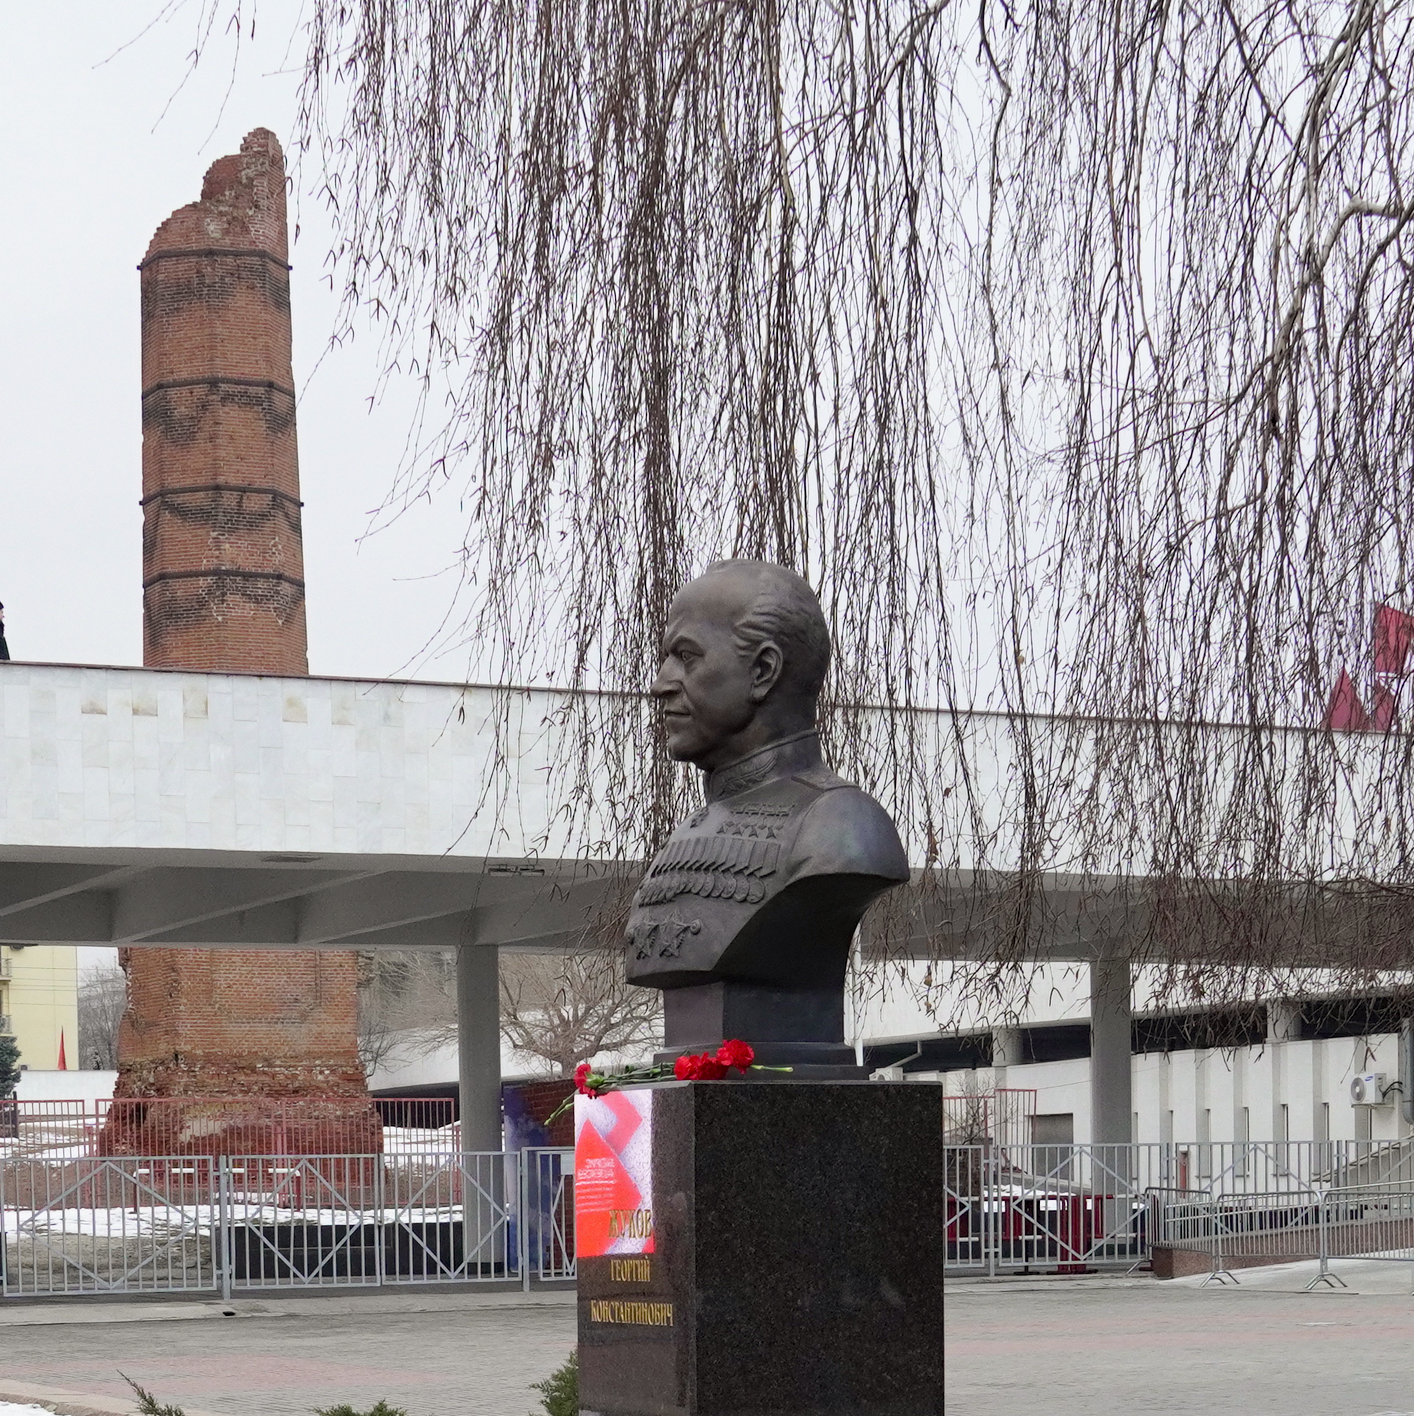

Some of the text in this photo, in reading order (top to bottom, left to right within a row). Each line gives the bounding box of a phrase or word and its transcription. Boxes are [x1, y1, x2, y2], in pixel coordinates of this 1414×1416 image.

[608, 1208, 652, 1239] ЖУКОВ
[610, 1255, 651, 1282] ГЕОРГИЙ
[590, 1300, 674, 1327] КОНСТАНТИНОВИЧ
